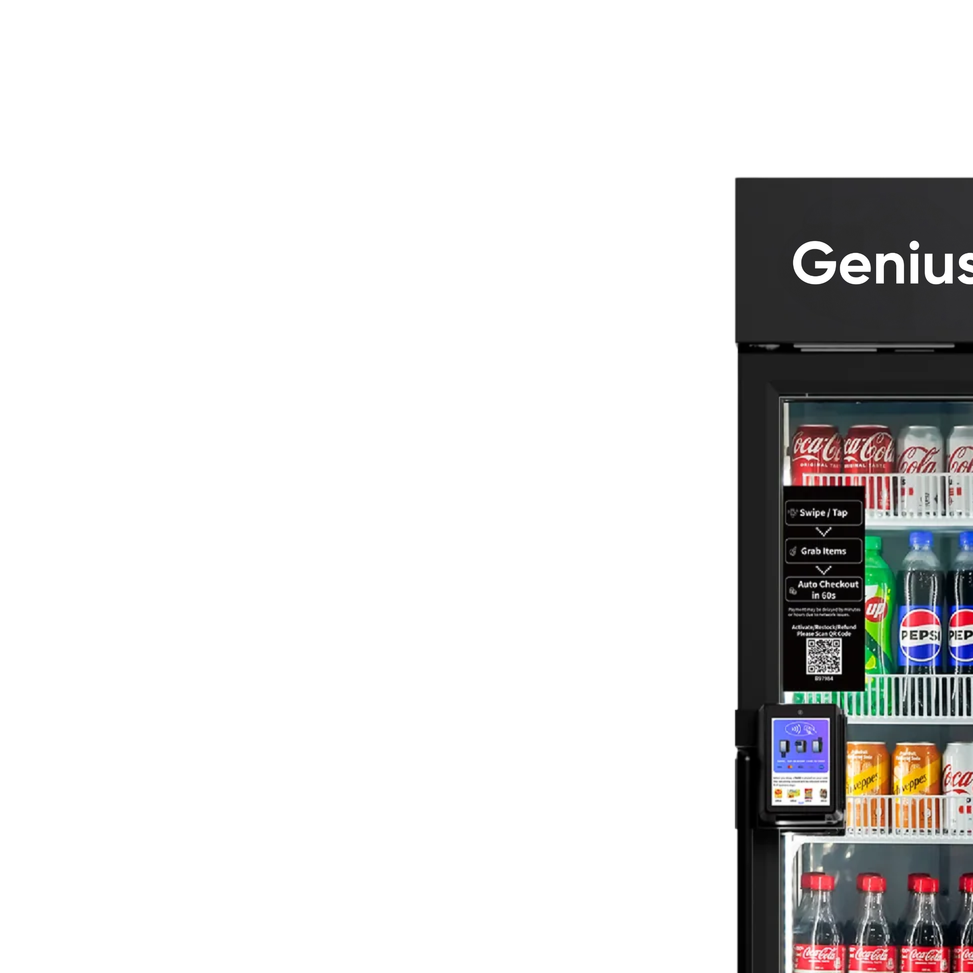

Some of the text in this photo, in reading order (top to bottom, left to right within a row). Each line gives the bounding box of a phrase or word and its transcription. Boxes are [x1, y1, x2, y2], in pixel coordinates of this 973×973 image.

[800, 508, 848, 518] Swipe / Tap
[801, 547, 846, 555] Grab Items
[819, 580, 859, 588] Checkout
[812, 591, 836, 599] in 60s
[902, 630, 941, 641] PEPSI
[802, 947, 836, 960] Coca-Cola
[855, 947, 889, 961] Coca-Cola
[909, 948, 943, 961] Coca-Cola
